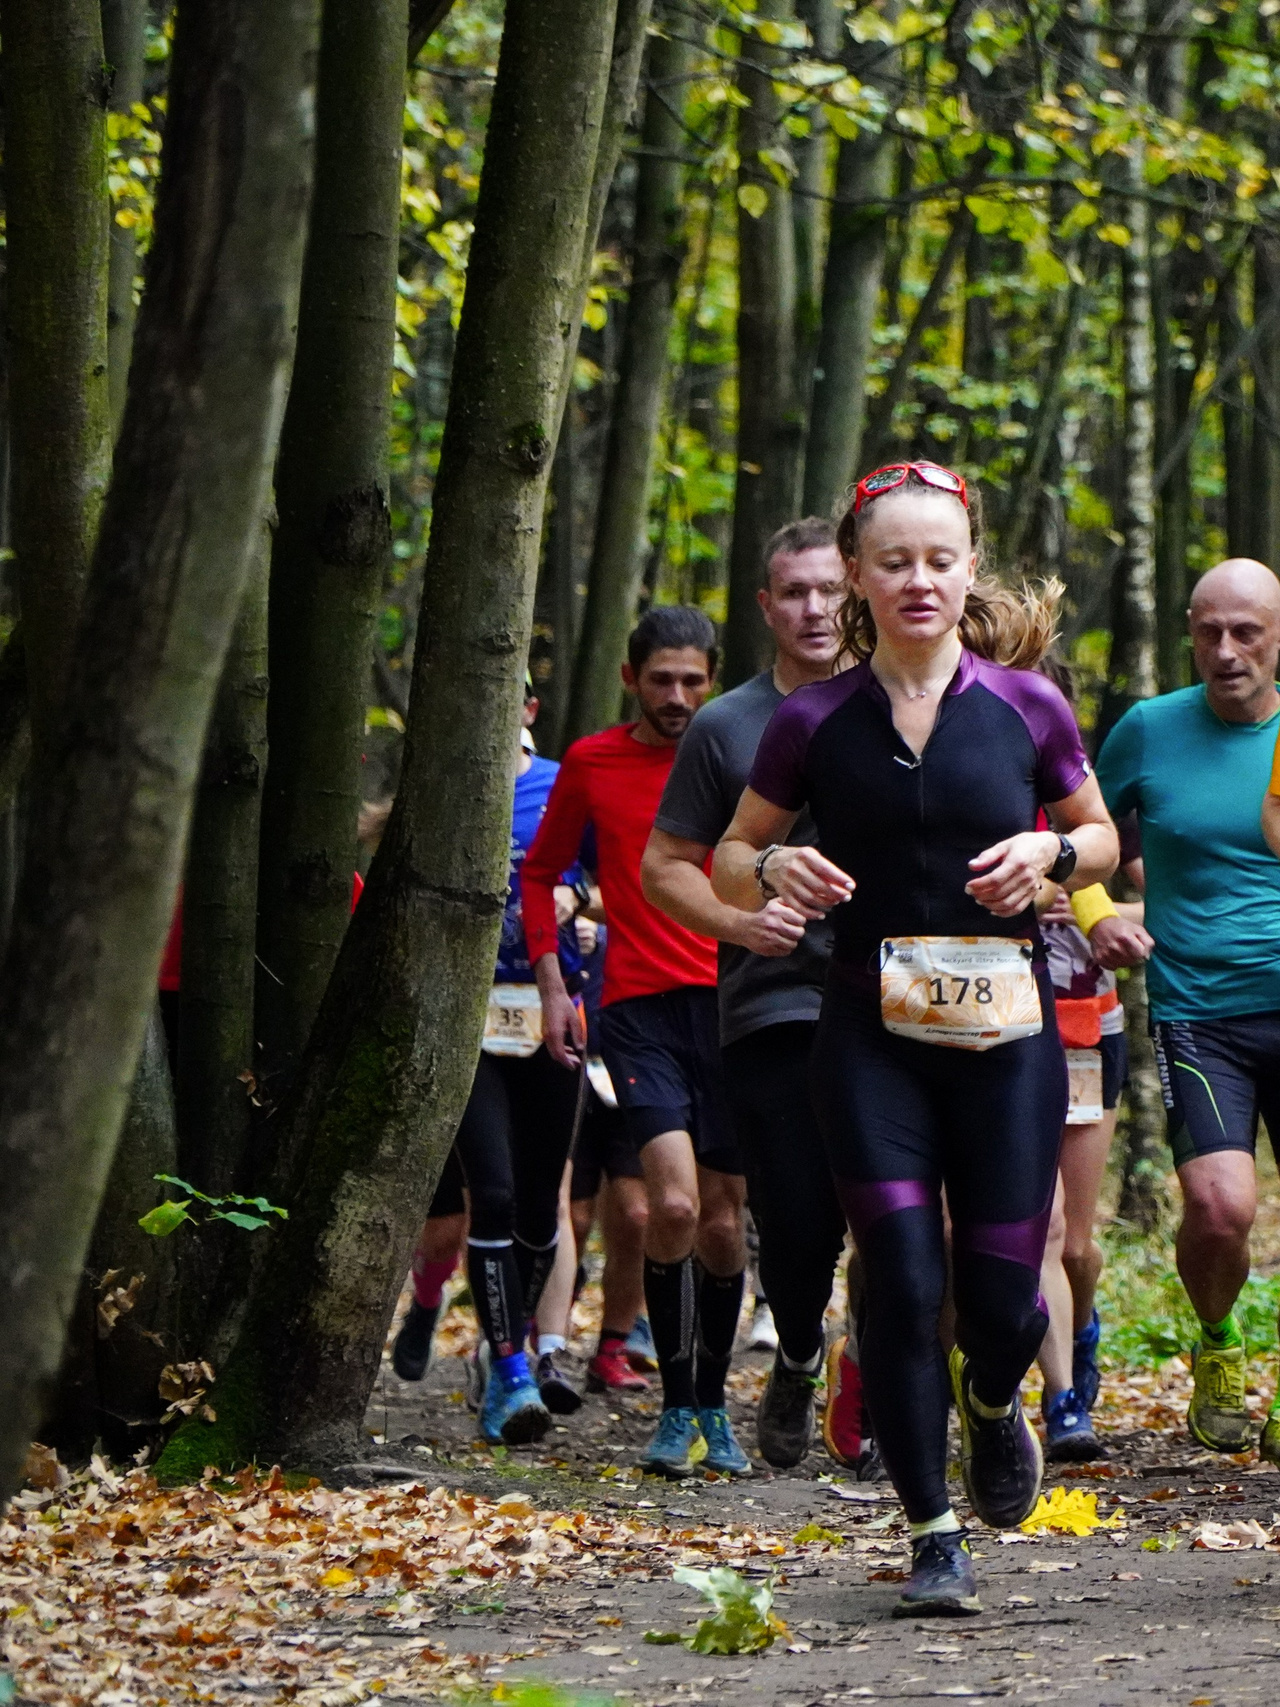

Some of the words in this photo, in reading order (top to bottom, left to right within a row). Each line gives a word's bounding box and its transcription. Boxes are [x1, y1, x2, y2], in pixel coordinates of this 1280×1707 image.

[941, 956, 973, 966] Backyard
[929, 976, 994, 1006] 178
[498, 1007, 524, 1027] 35
